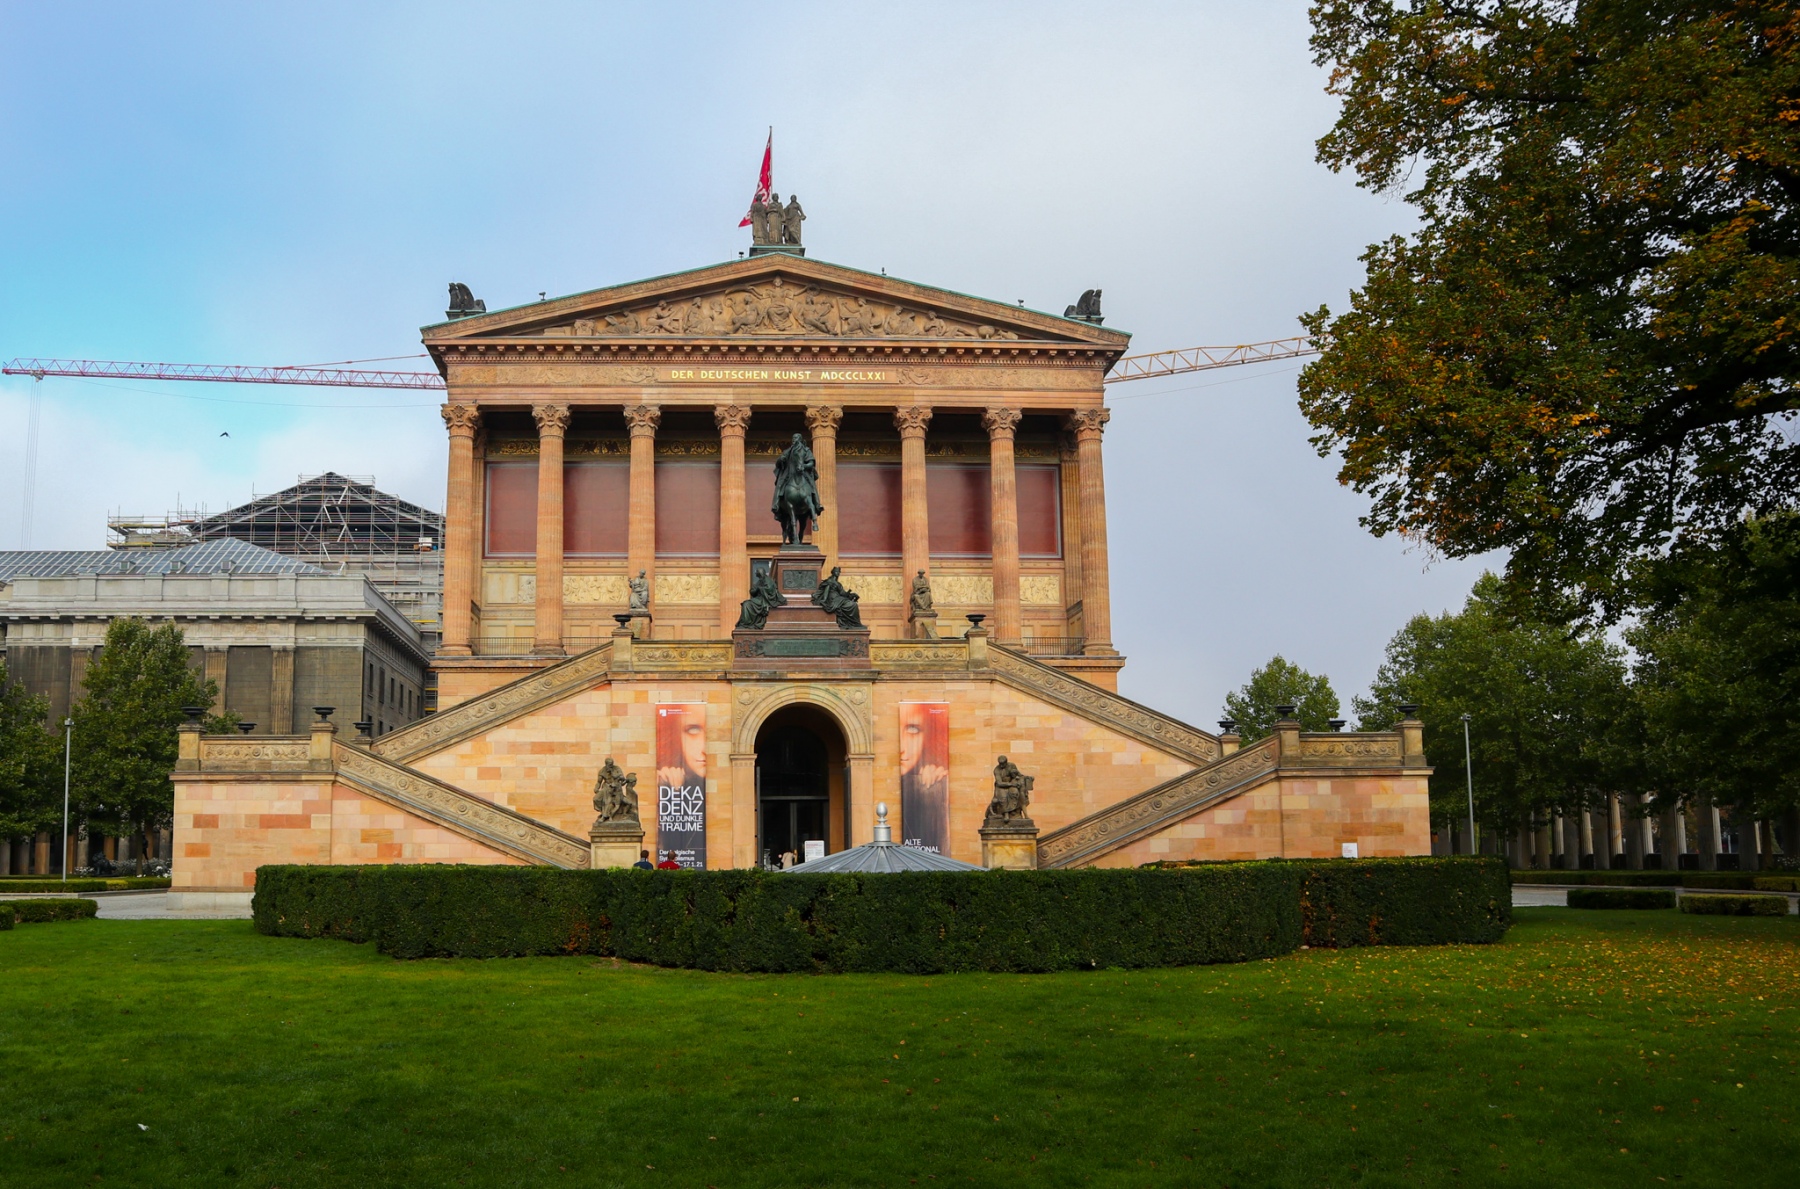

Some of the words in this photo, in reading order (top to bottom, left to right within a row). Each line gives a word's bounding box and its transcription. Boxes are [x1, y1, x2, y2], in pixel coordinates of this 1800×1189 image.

[671, 371, 694, 379] DER
[701, 371, 768, 379] DEUTSCHEN
[774, 371, 811, 380] KUNST
[821, 371, 886, 380] MDCCCLXXI
[660, 786, 704, 800] DEKA
[660, 801, 703, 815] DENZ
[660, 822, 703, 831] TRÄUME
